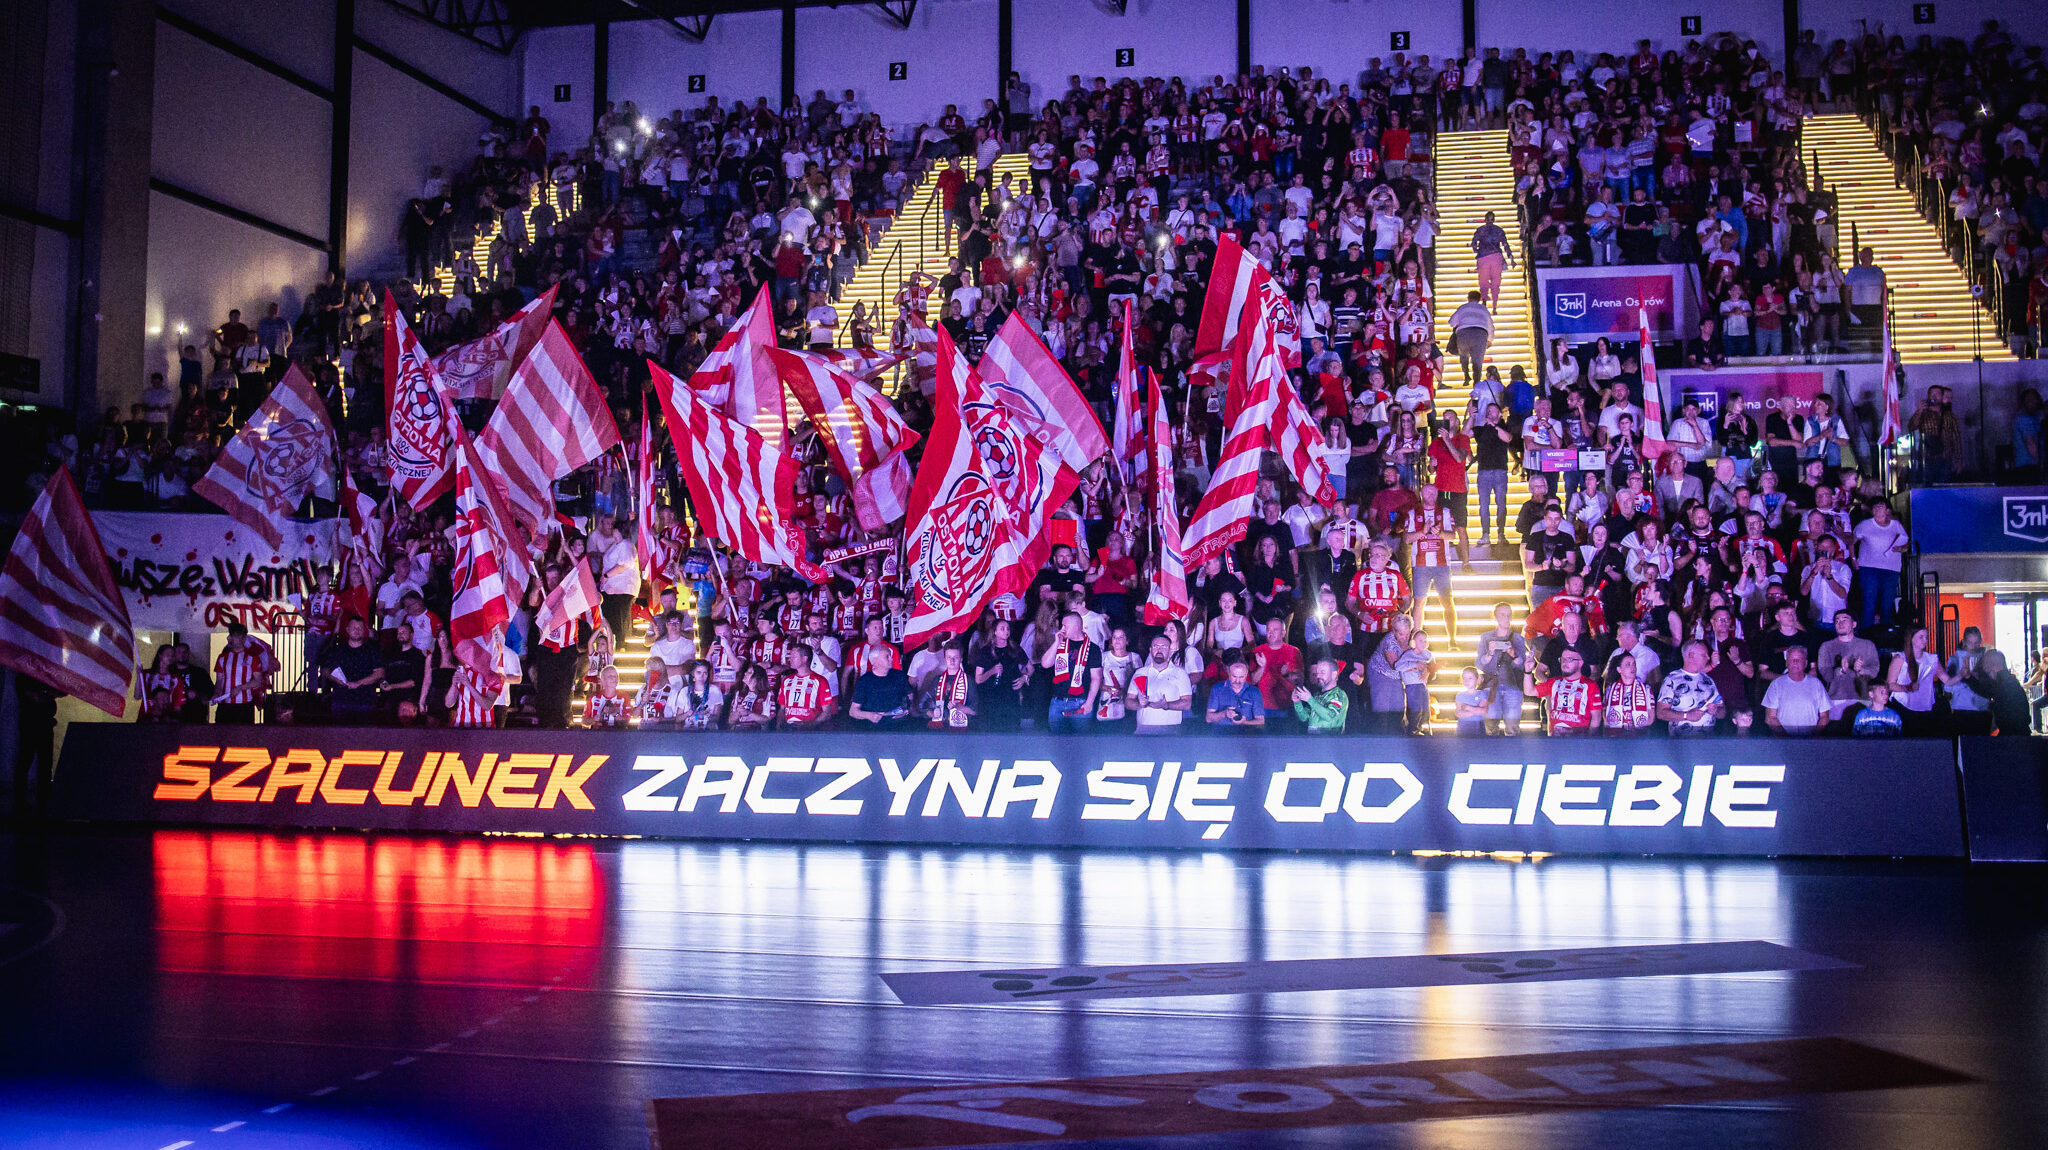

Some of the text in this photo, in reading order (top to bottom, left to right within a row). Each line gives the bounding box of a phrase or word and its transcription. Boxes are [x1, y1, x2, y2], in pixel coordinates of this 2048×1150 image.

[1920, 6, 1929, 20] 5
[1686, 18, 1695, 32] 4
[1396, 33, 1404, 47] 3
[1121, 51, 1129, 64] 3
[894, 64, 902, 77] 2
[693, 77, 700, 90] 2
[559, 86, 565, 99] 1
[1558, 295, 1665, 312] 3mk Arena Osrów
[1697, 396, 1716, 412] mk
[1765, 398, 1813, 411] Osów
[393, 409, 442, 462] STROVIA
[920, 531, 931, 560] KLUB
[934, 553, 946, 569] 19
[937, 512, 964, 602] OSTROVIA
[922, 591, 946, 611] ZNEJ
[793, 691, 801, 702] 17
[1562, 695, 1569, 707] 3
[153, 746, 1786, 839] SZACUNEK ZACZYNA SIĘ OD CIEBIE
[1191, 1054, 1791, 1114] ORLEN
